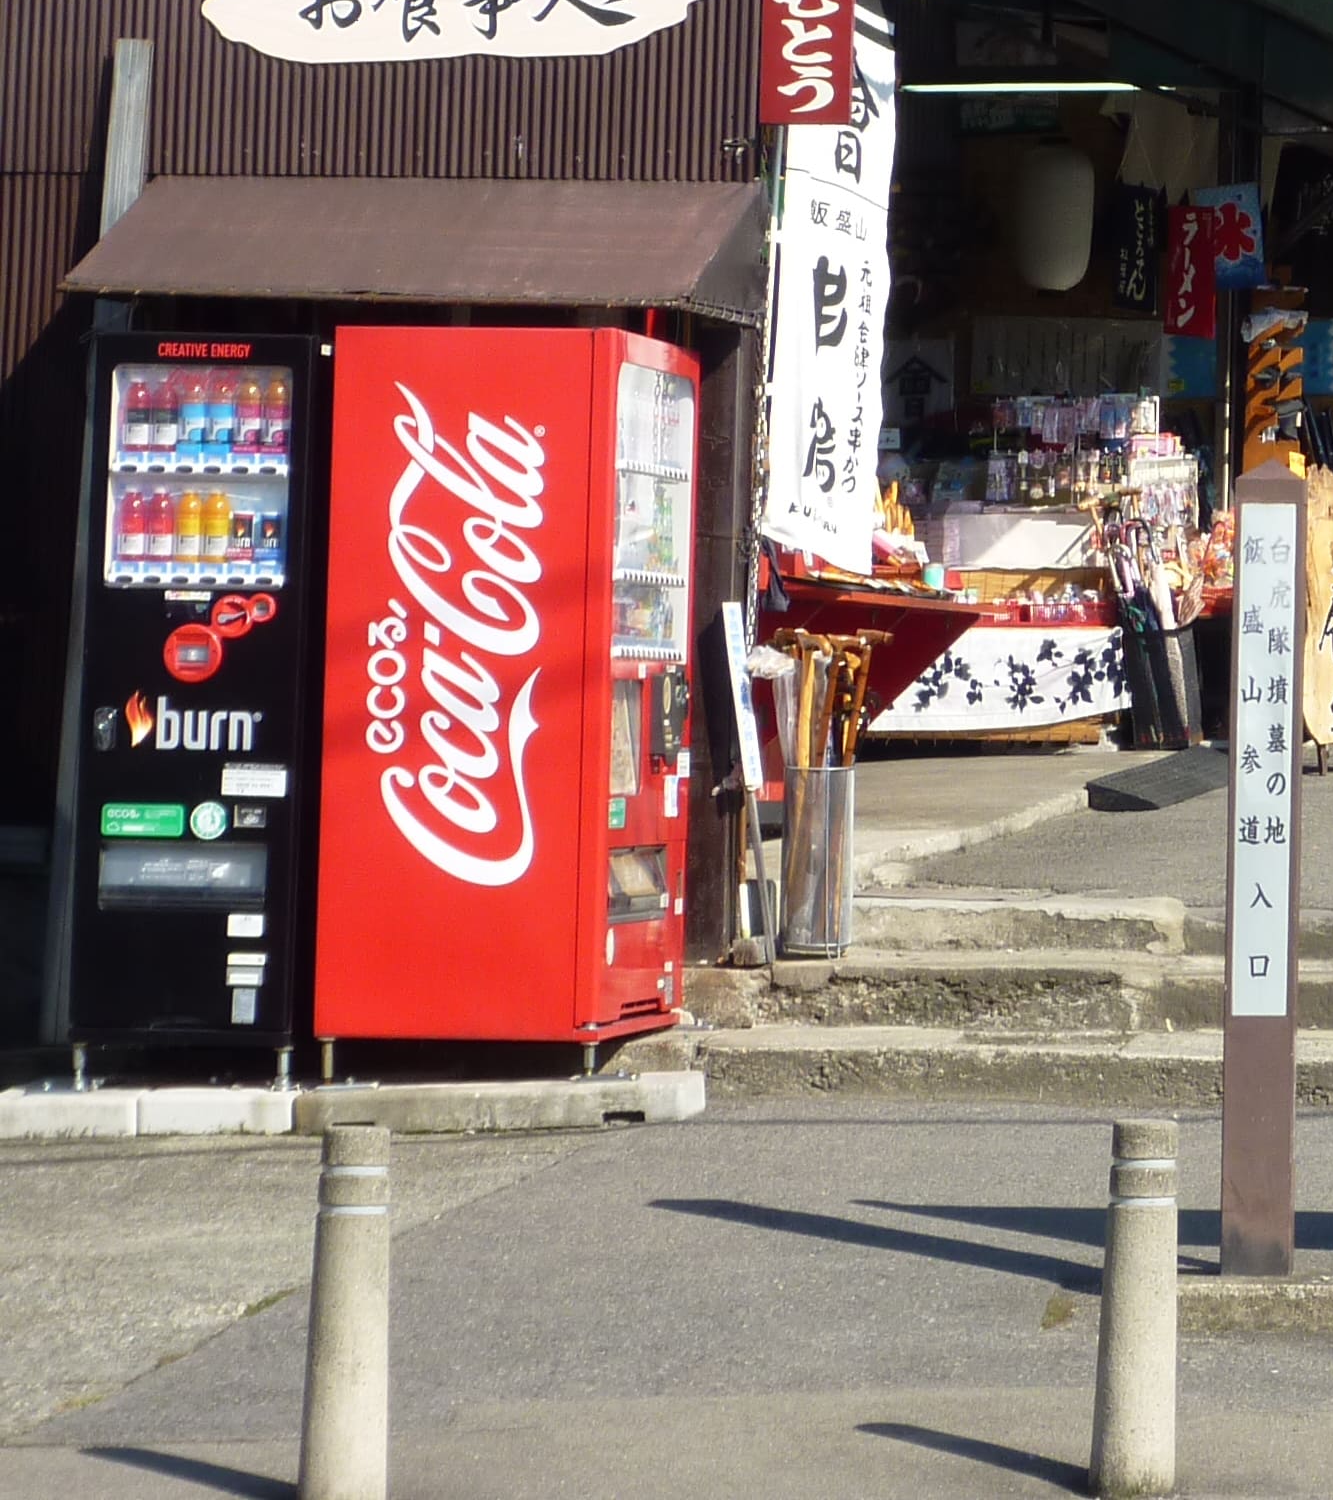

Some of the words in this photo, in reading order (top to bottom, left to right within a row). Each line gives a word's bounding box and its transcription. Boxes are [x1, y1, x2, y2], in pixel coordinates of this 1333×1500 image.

[157, 342, 208, 358] CREATIVE
[210, 343, 252, 359] ENERGY
[1176, 211, 1199, 330] ラーメン
[155, 695, 253, 752] burn
[379, 380, 547, 888] Coca-Cola
[1264, 535, 1292, 844] 白虎隊墳墓の地
[1237, 535, 1274, 978] 飯盛山参道入口
